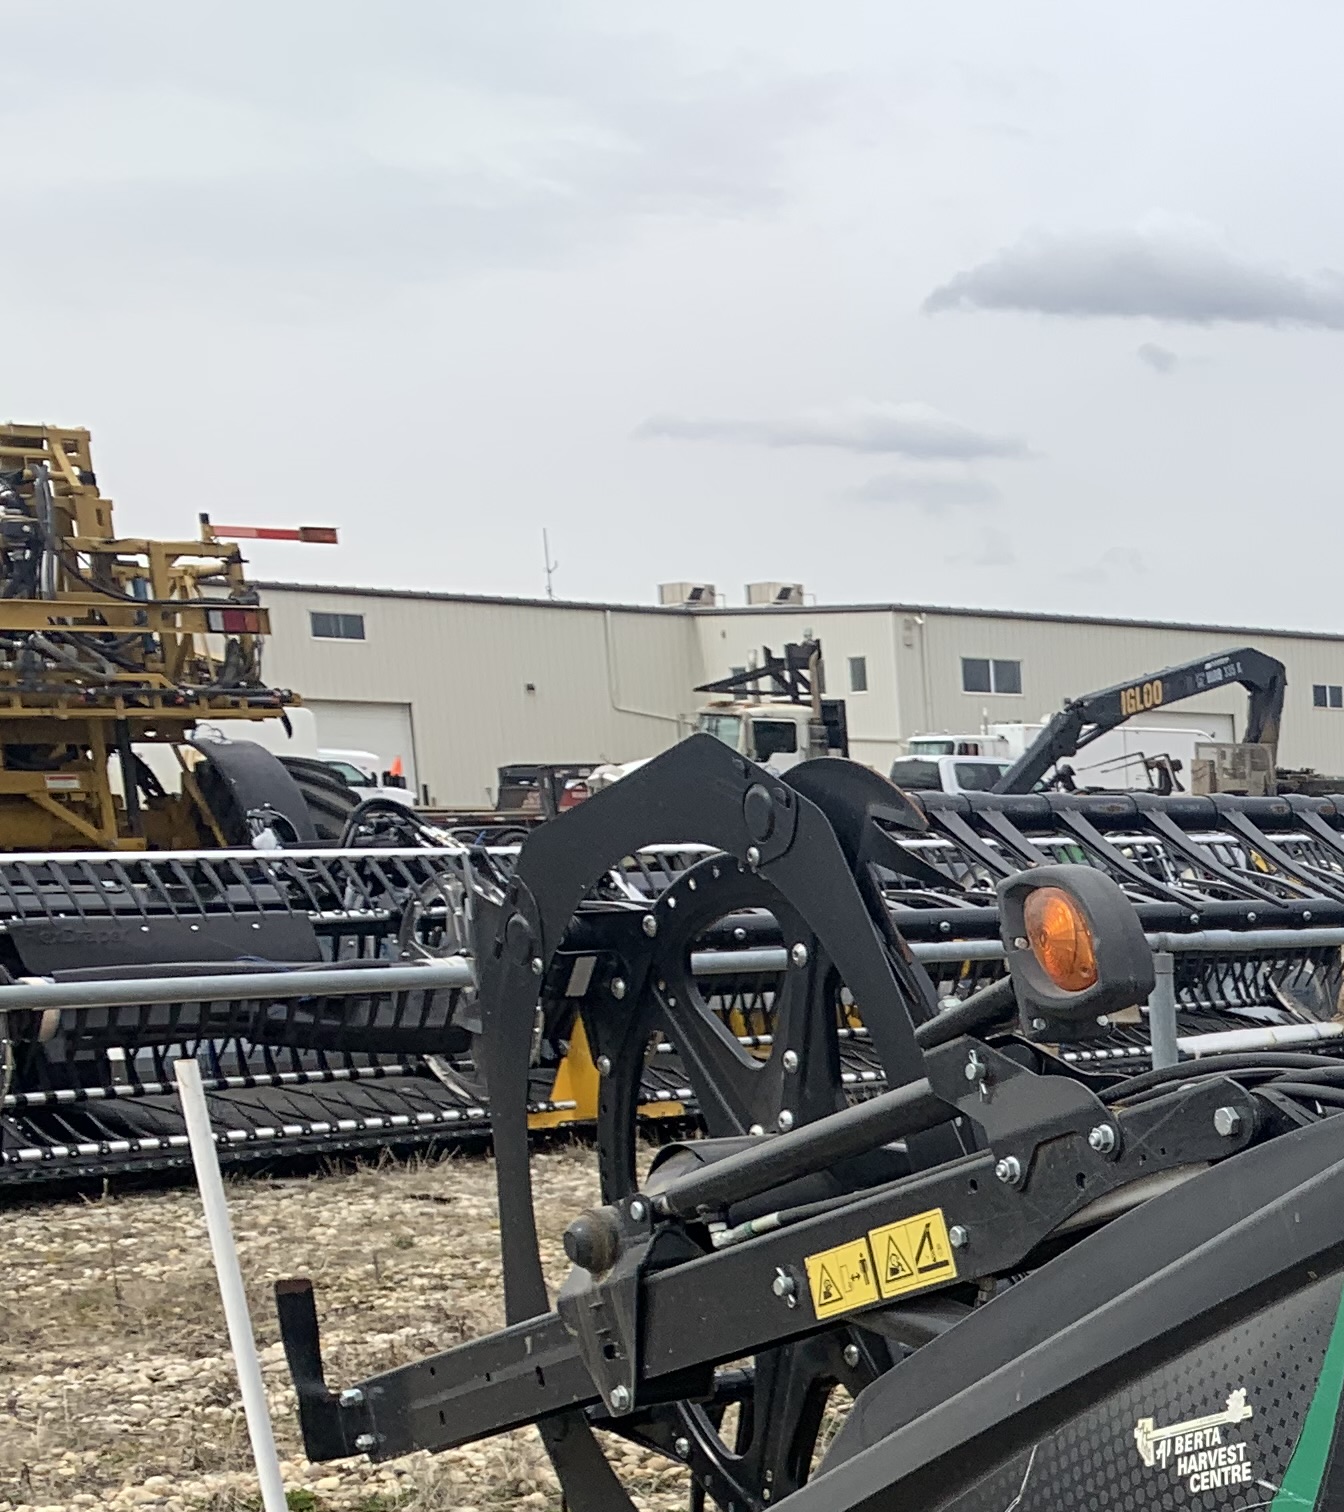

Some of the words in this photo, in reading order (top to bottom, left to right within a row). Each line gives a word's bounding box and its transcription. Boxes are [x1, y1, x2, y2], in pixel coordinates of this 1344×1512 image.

[1121, 680, 1163, 715] IGLOO
[1177, 1441, 1247, 1477] HARVEST
[1189, 1461, 1252, 1493] CENTRE
